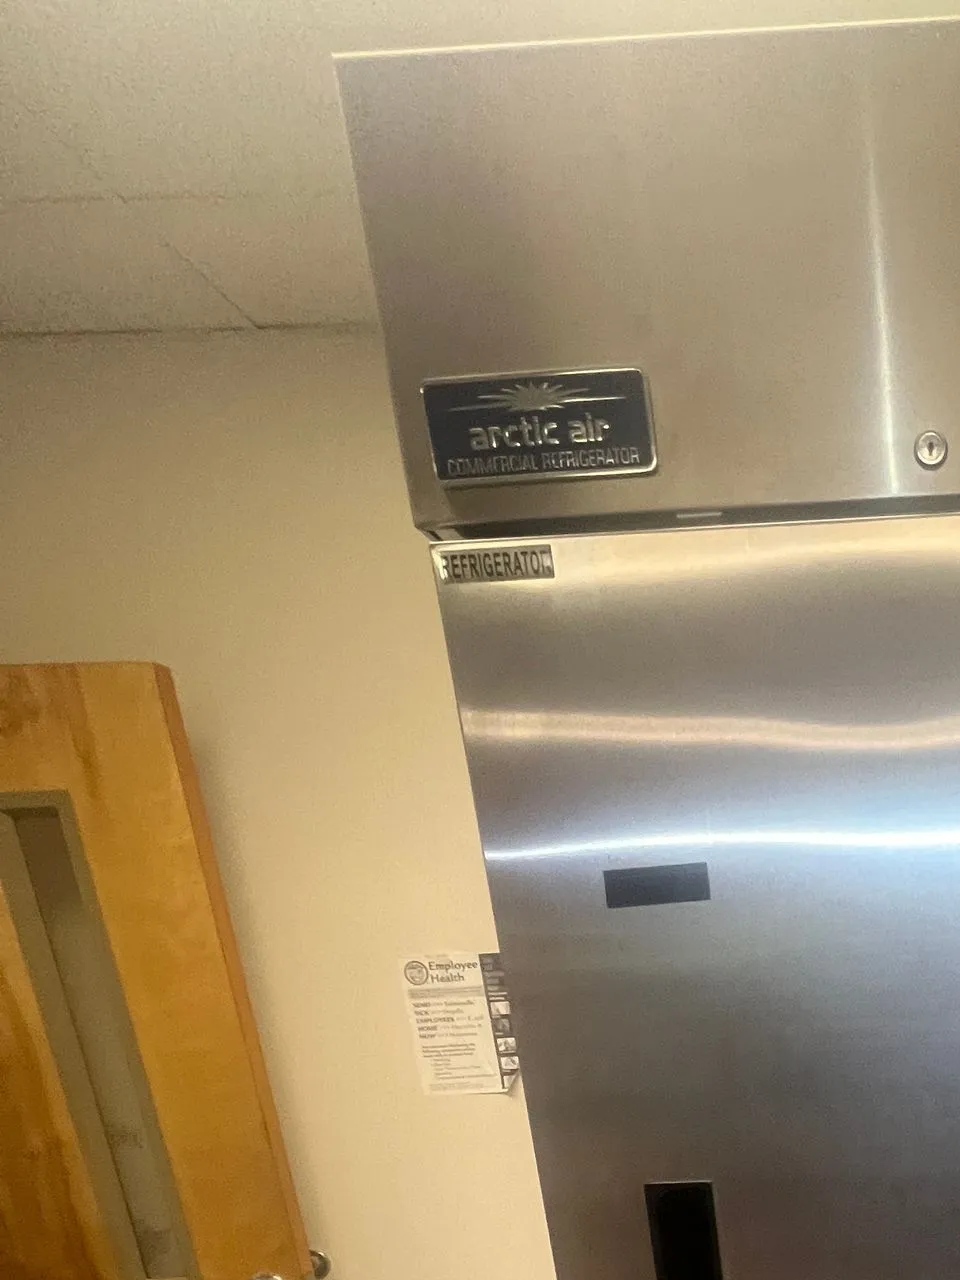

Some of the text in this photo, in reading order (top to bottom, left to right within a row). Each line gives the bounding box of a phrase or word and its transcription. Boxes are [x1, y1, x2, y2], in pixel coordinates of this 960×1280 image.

[468, 412, 610, 451] arctic air
[447, 446, 641, 477] COMMERCIAL REFRIGERATOR
[428, 960, 478, 972] Employee
[430, 973, 465, 984] Health
